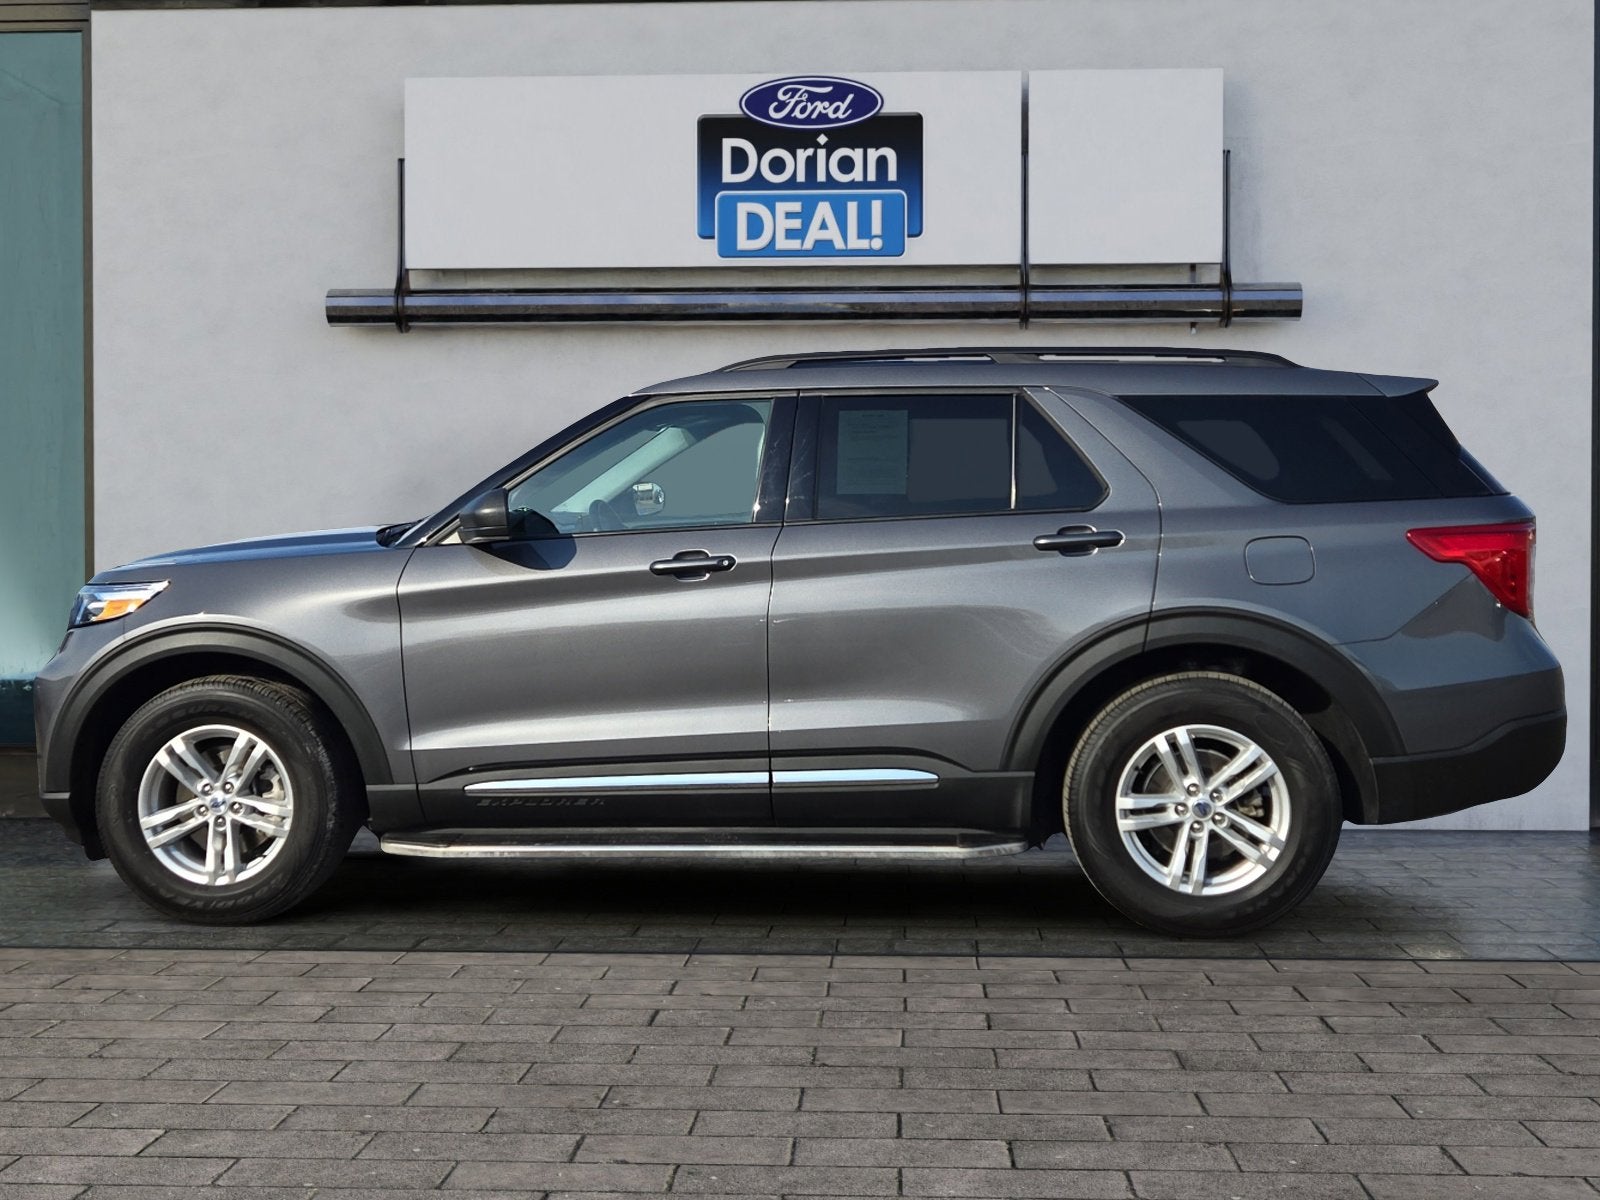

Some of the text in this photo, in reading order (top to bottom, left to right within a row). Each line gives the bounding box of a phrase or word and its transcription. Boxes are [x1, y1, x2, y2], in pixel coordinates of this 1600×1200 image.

[768, 84, 854, 120] Ford
[721, 133, 898, 184] Dorian
[736, 199, 884, 251] DEAL!
